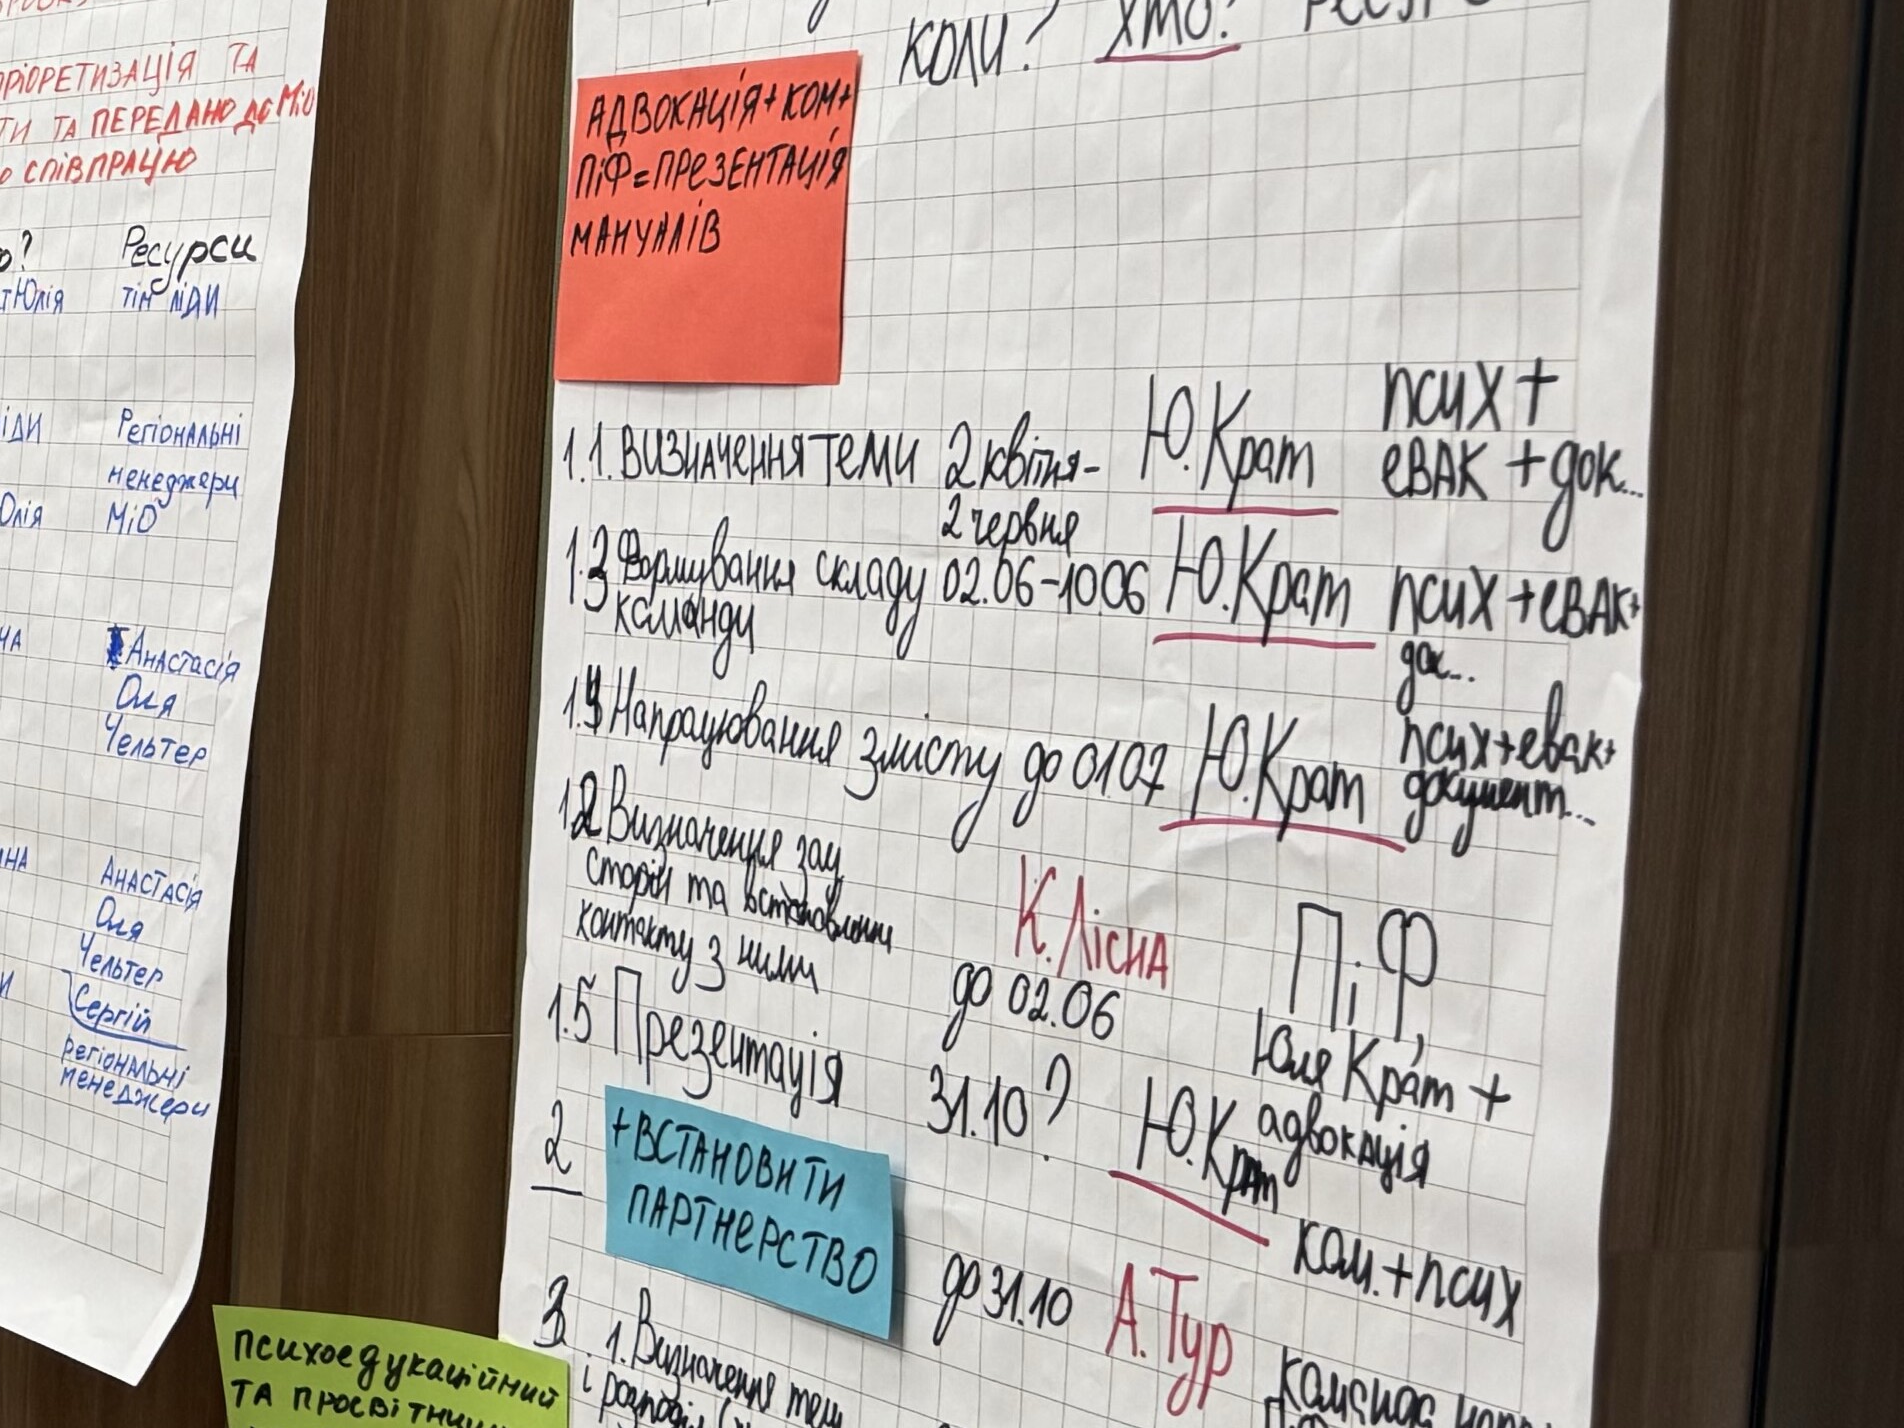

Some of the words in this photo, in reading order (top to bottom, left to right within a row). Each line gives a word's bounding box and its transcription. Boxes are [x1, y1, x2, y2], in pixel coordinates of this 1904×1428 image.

[53, 112, 77, 142] ТА
[120, 223, 258, 296] Ресурси
[1012, 740, 1063, 829] до
[613, 964, 845, 1121] Презентація
[941, 960, 992, 1052] до
[931, 1250, 982, 1348] до
